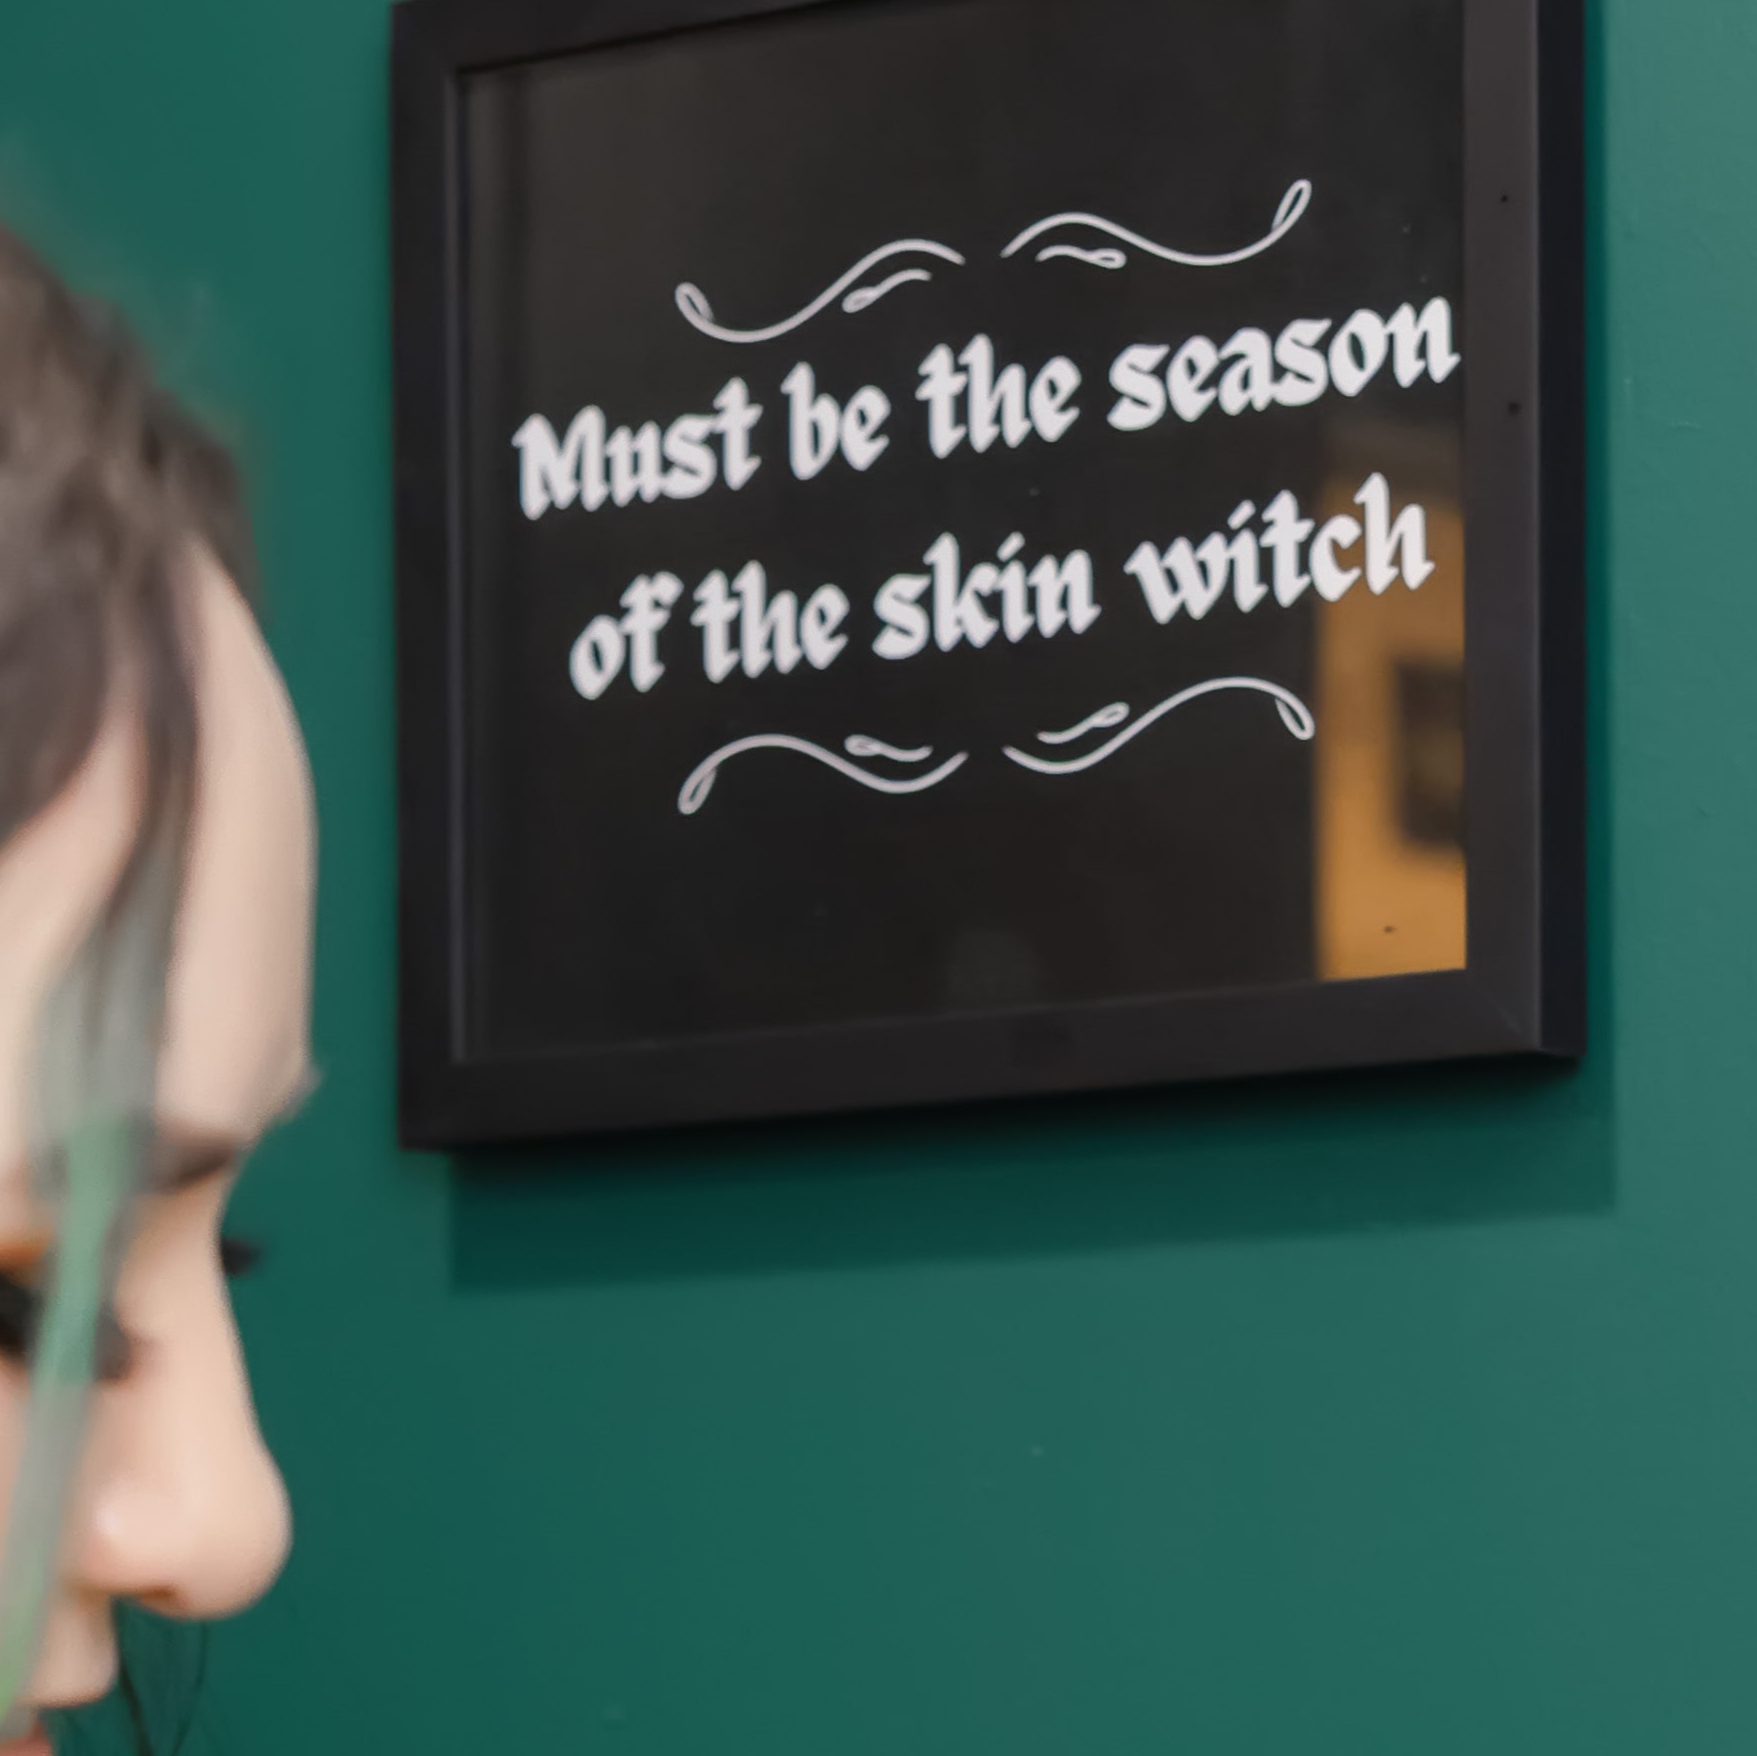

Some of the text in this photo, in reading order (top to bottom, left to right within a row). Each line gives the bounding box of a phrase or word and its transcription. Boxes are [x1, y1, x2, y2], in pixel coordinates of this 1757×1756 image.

[512, 296, 1461, 520] Must be the season
[569, 472, 1436, 701] of the skin witch
